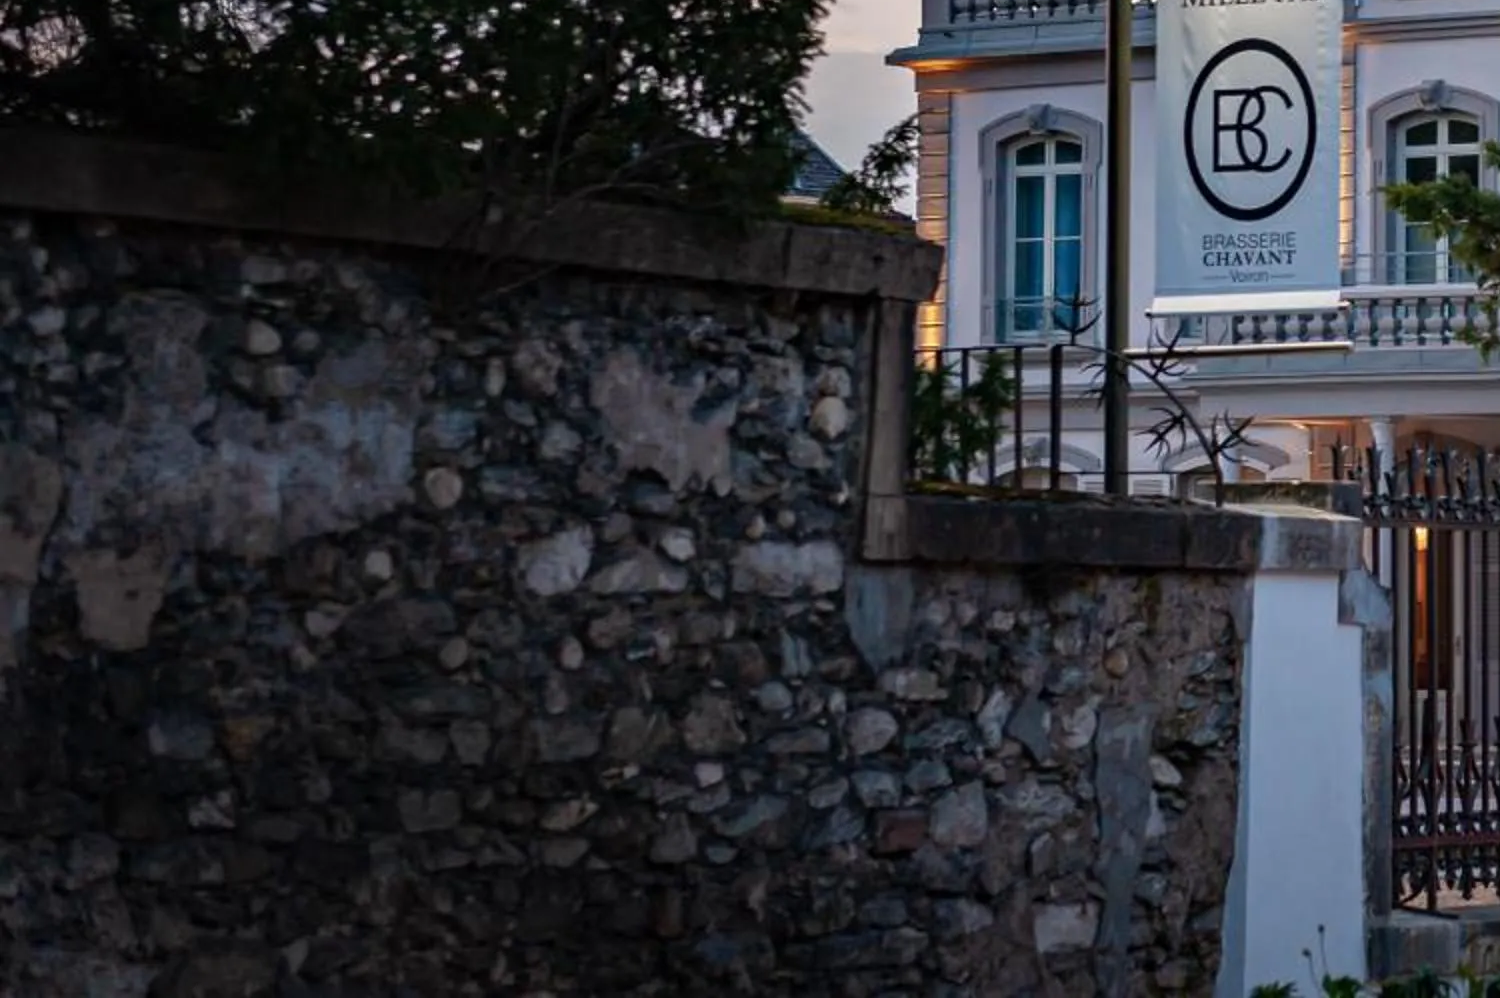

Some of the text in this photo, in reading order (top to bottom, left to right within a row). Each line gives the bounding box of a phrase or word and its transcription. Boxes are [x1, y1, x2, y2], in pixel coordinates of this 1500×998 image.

[1213, 85, 1293, 172] BC
[1202, 231, 1296, 251] BRASSERIE
[1202, 250, 1296, 267] CHAVANT
